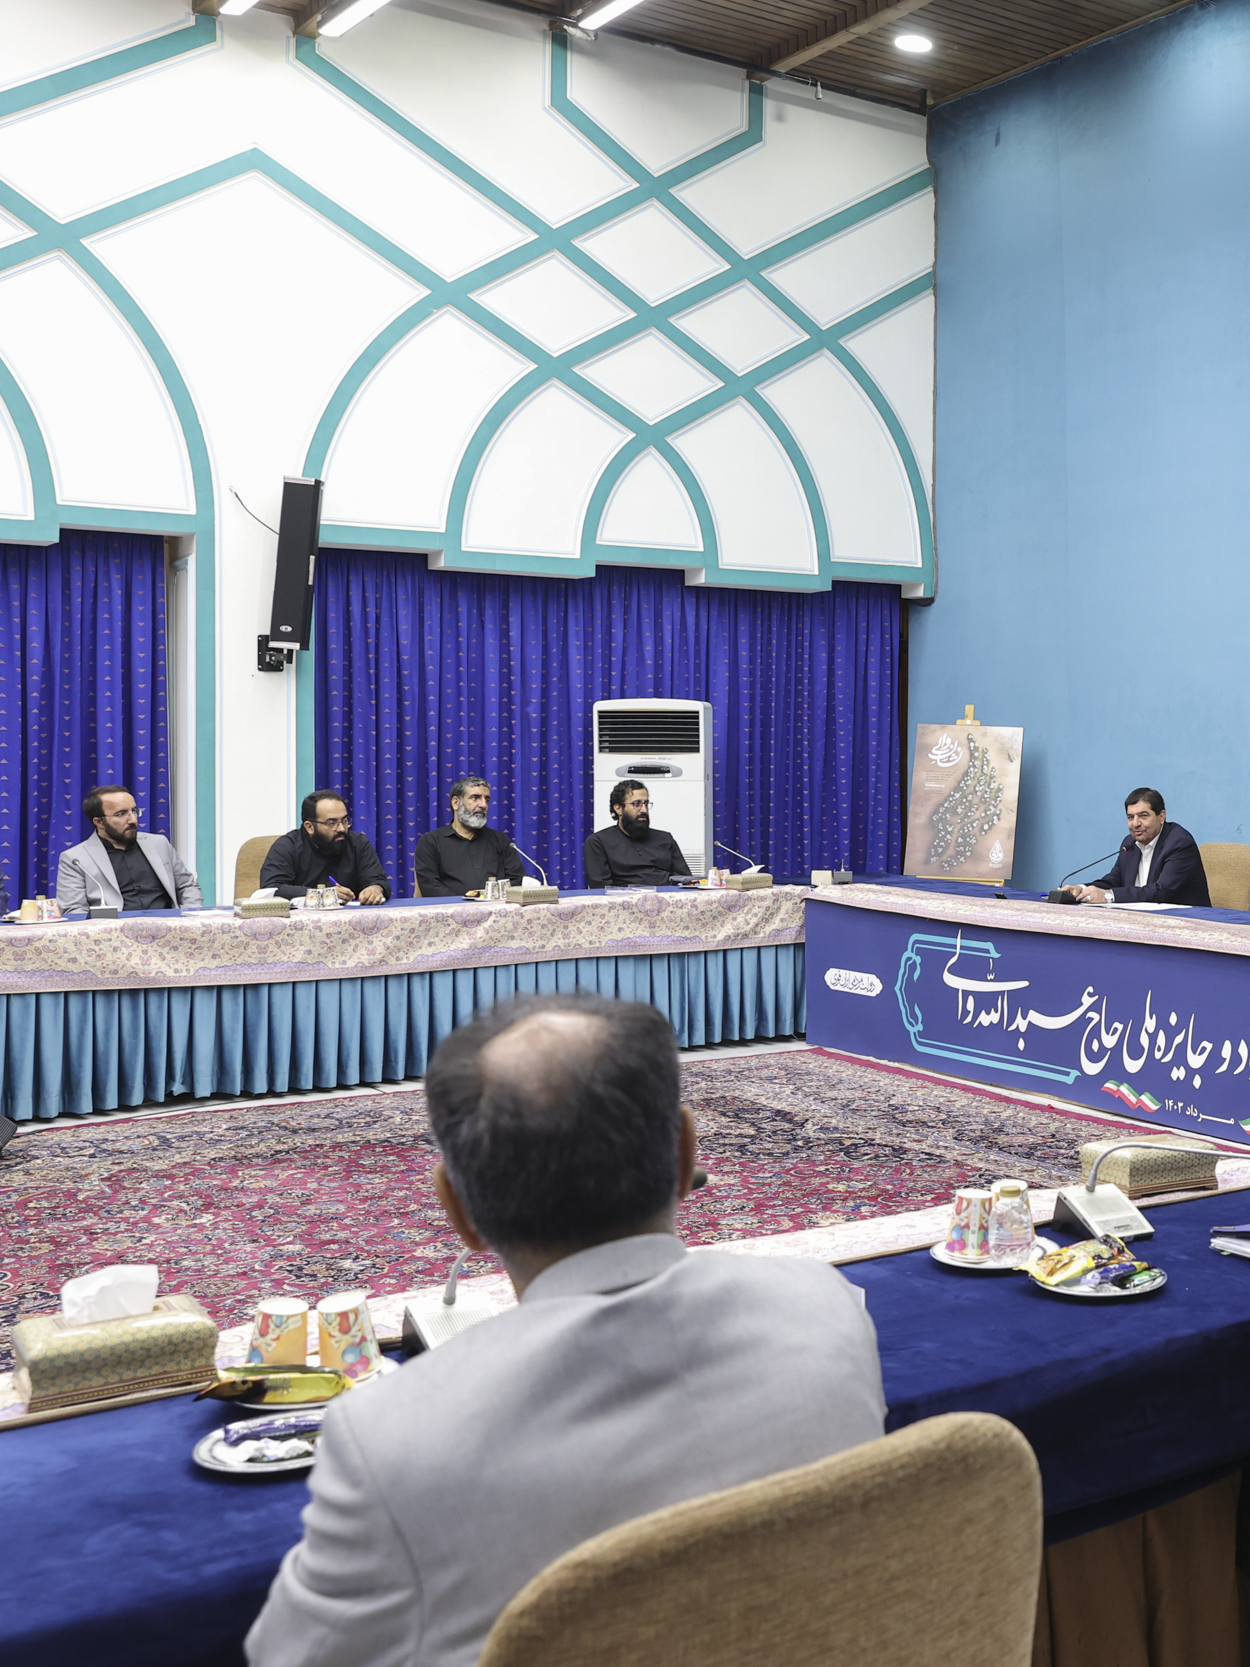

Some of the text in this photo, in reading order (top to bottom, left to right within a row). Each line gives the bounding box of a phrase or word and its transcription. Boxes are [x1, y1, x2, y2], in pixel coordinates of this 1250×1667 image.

[974, 958, 1098, 1051] عبدالله
[1080, 996, 1124, 1075] حاج
[1123, 990, 1157, 1073] ملی
[1154, 1011, 1213, 1089] جایزه
[1215, 1039, 1232, 1074] و
[1164, 1098, 1235, 1125] مرداد ۱۴۰۳
